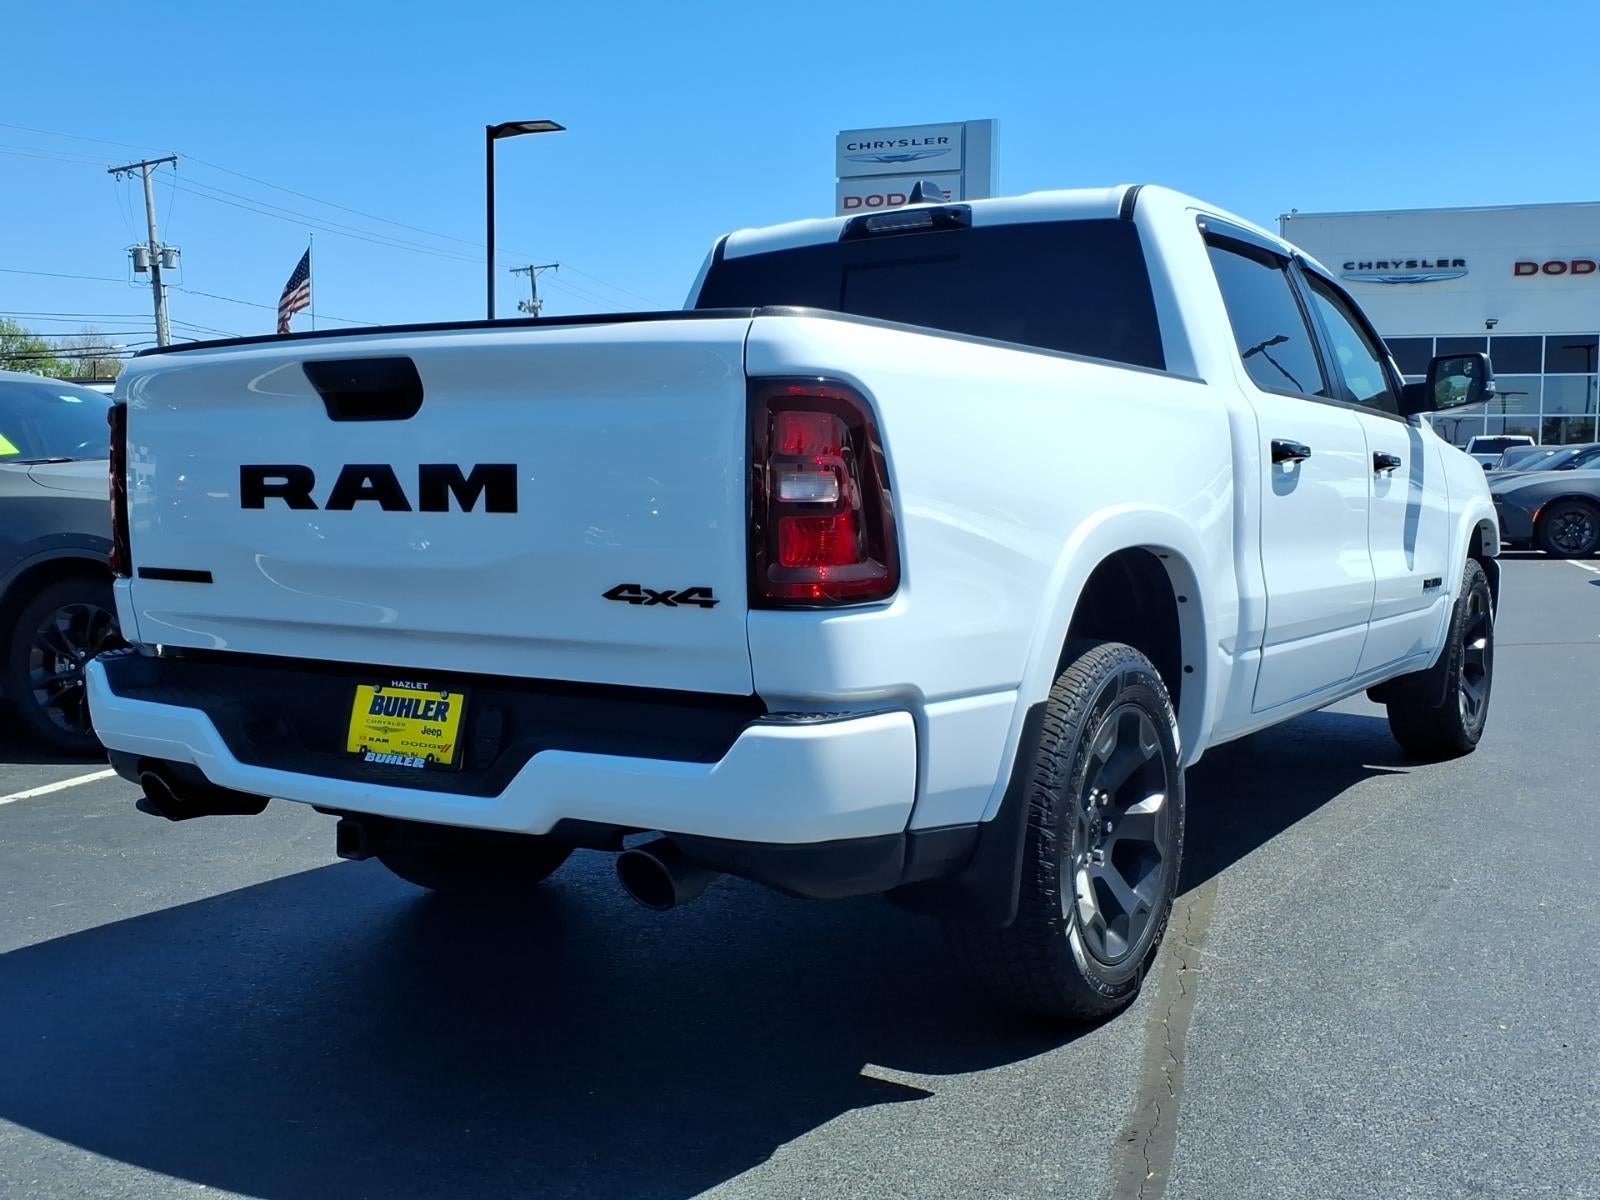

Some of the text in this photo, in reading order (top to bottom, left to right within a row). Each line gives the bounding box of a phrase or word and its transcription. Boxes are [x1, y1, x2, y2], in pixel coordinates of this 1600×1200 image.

[847, 136, 949, 151] CHRYSLER
[843, 190, 951, 209] DOD
[1343, 258, 1466, 270] CHRYSLER
[1513, 258, 1600, 276] DOD
[240, 463, 518, 513] RAM
[391, 680, 429, 690] HAZLET
[369, 695, 450, 722] BUHLER
[421, 725, 442, 738] Jeep
[401, 740, 444, 749] DODGE
[364, 751, 425, 768] BUHLER
